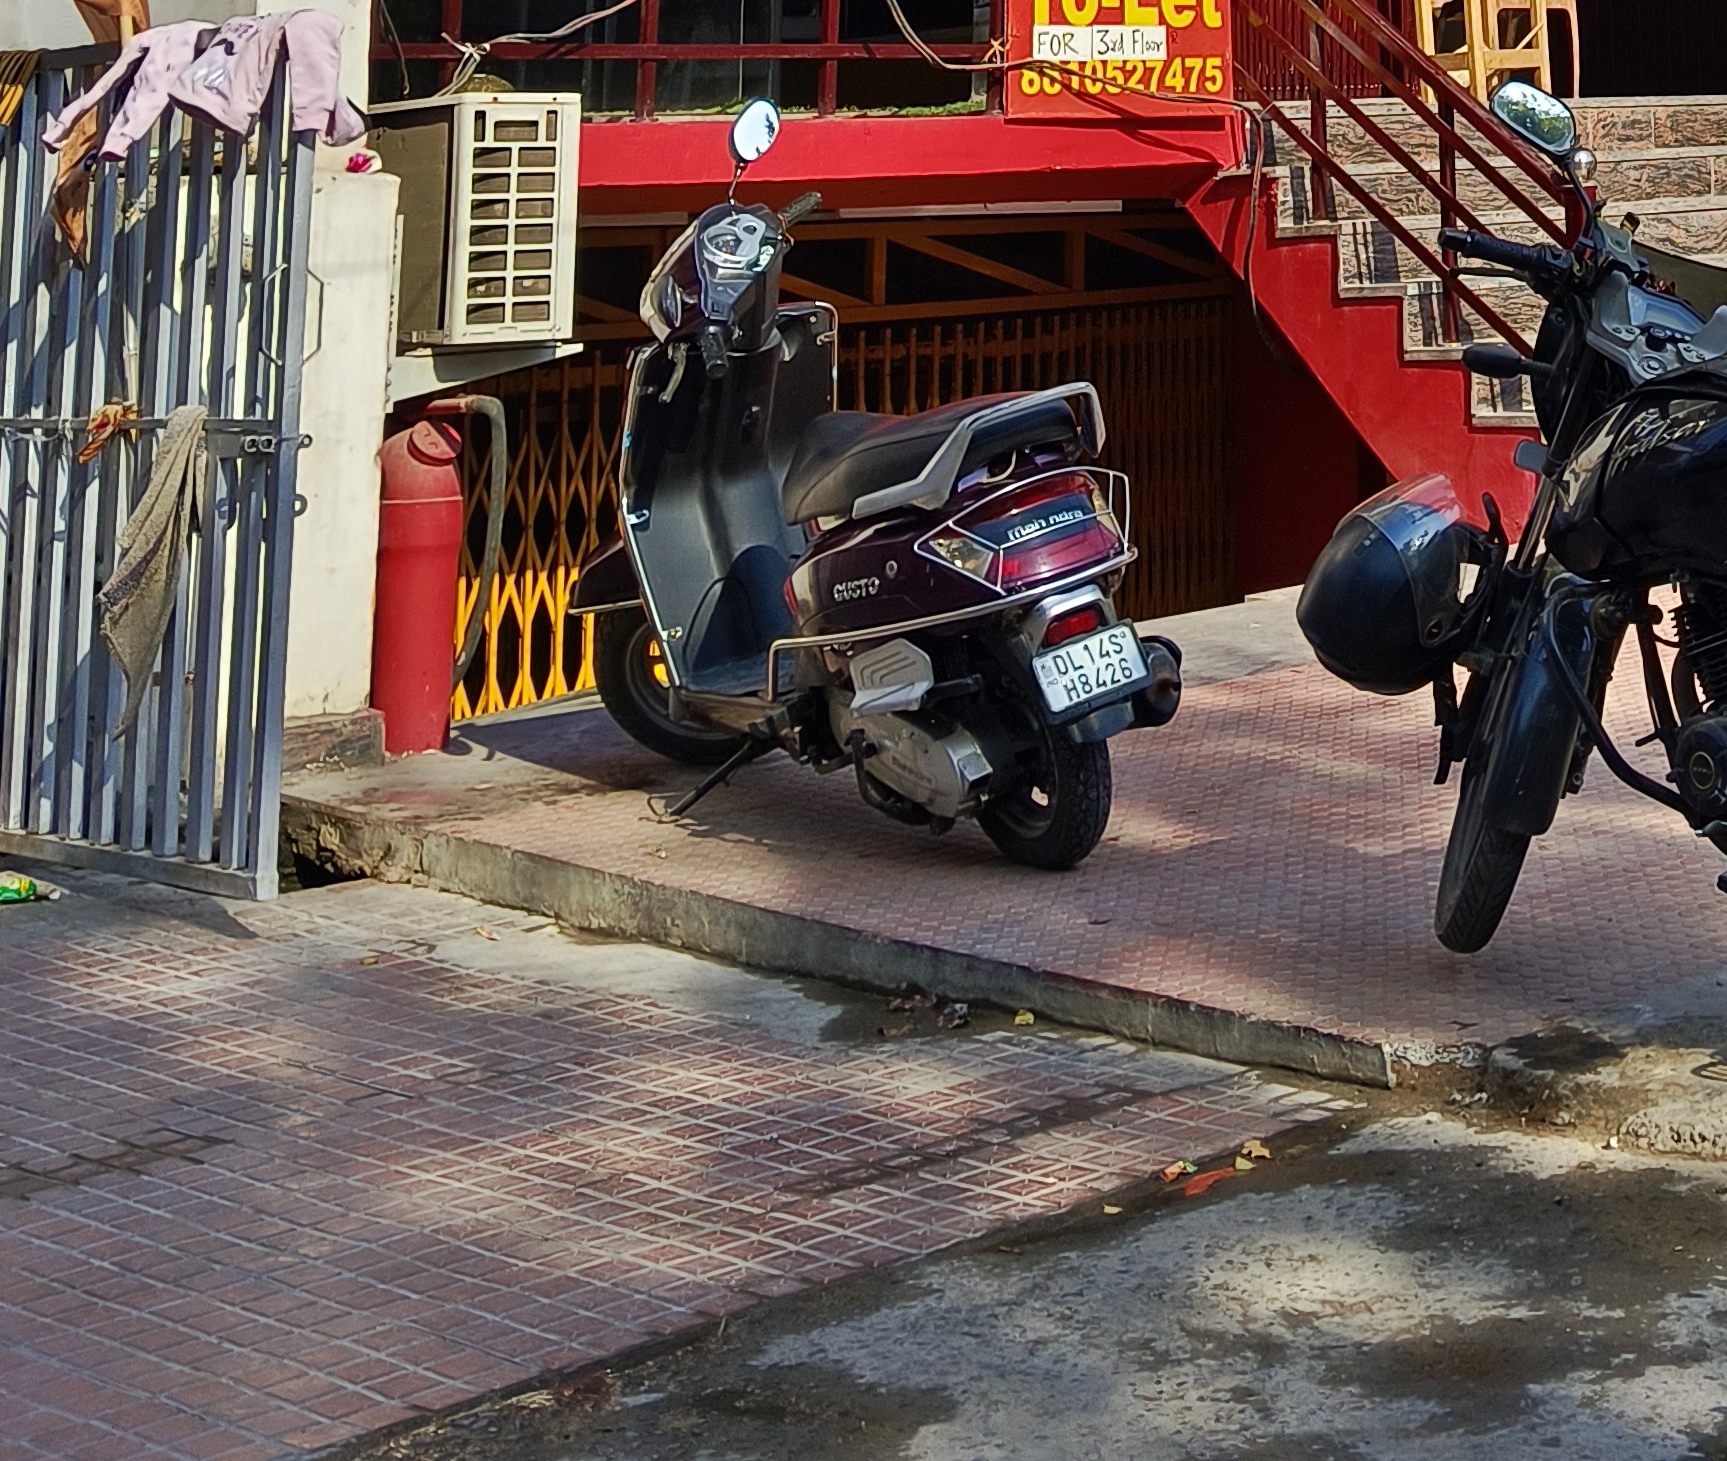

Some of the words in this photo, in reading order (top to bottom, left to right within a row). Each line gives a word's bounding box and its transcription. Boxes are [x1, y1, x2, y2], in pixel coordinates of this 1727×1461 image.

[1038, 32, 1079, 55] FOR
[1096, 29, 1125, 55] 3rd
[1132, 29, 1163, 53] Floor
[833, 576, 881, 602] GUSTO
[1064, 658, 1133, 703] H8426
